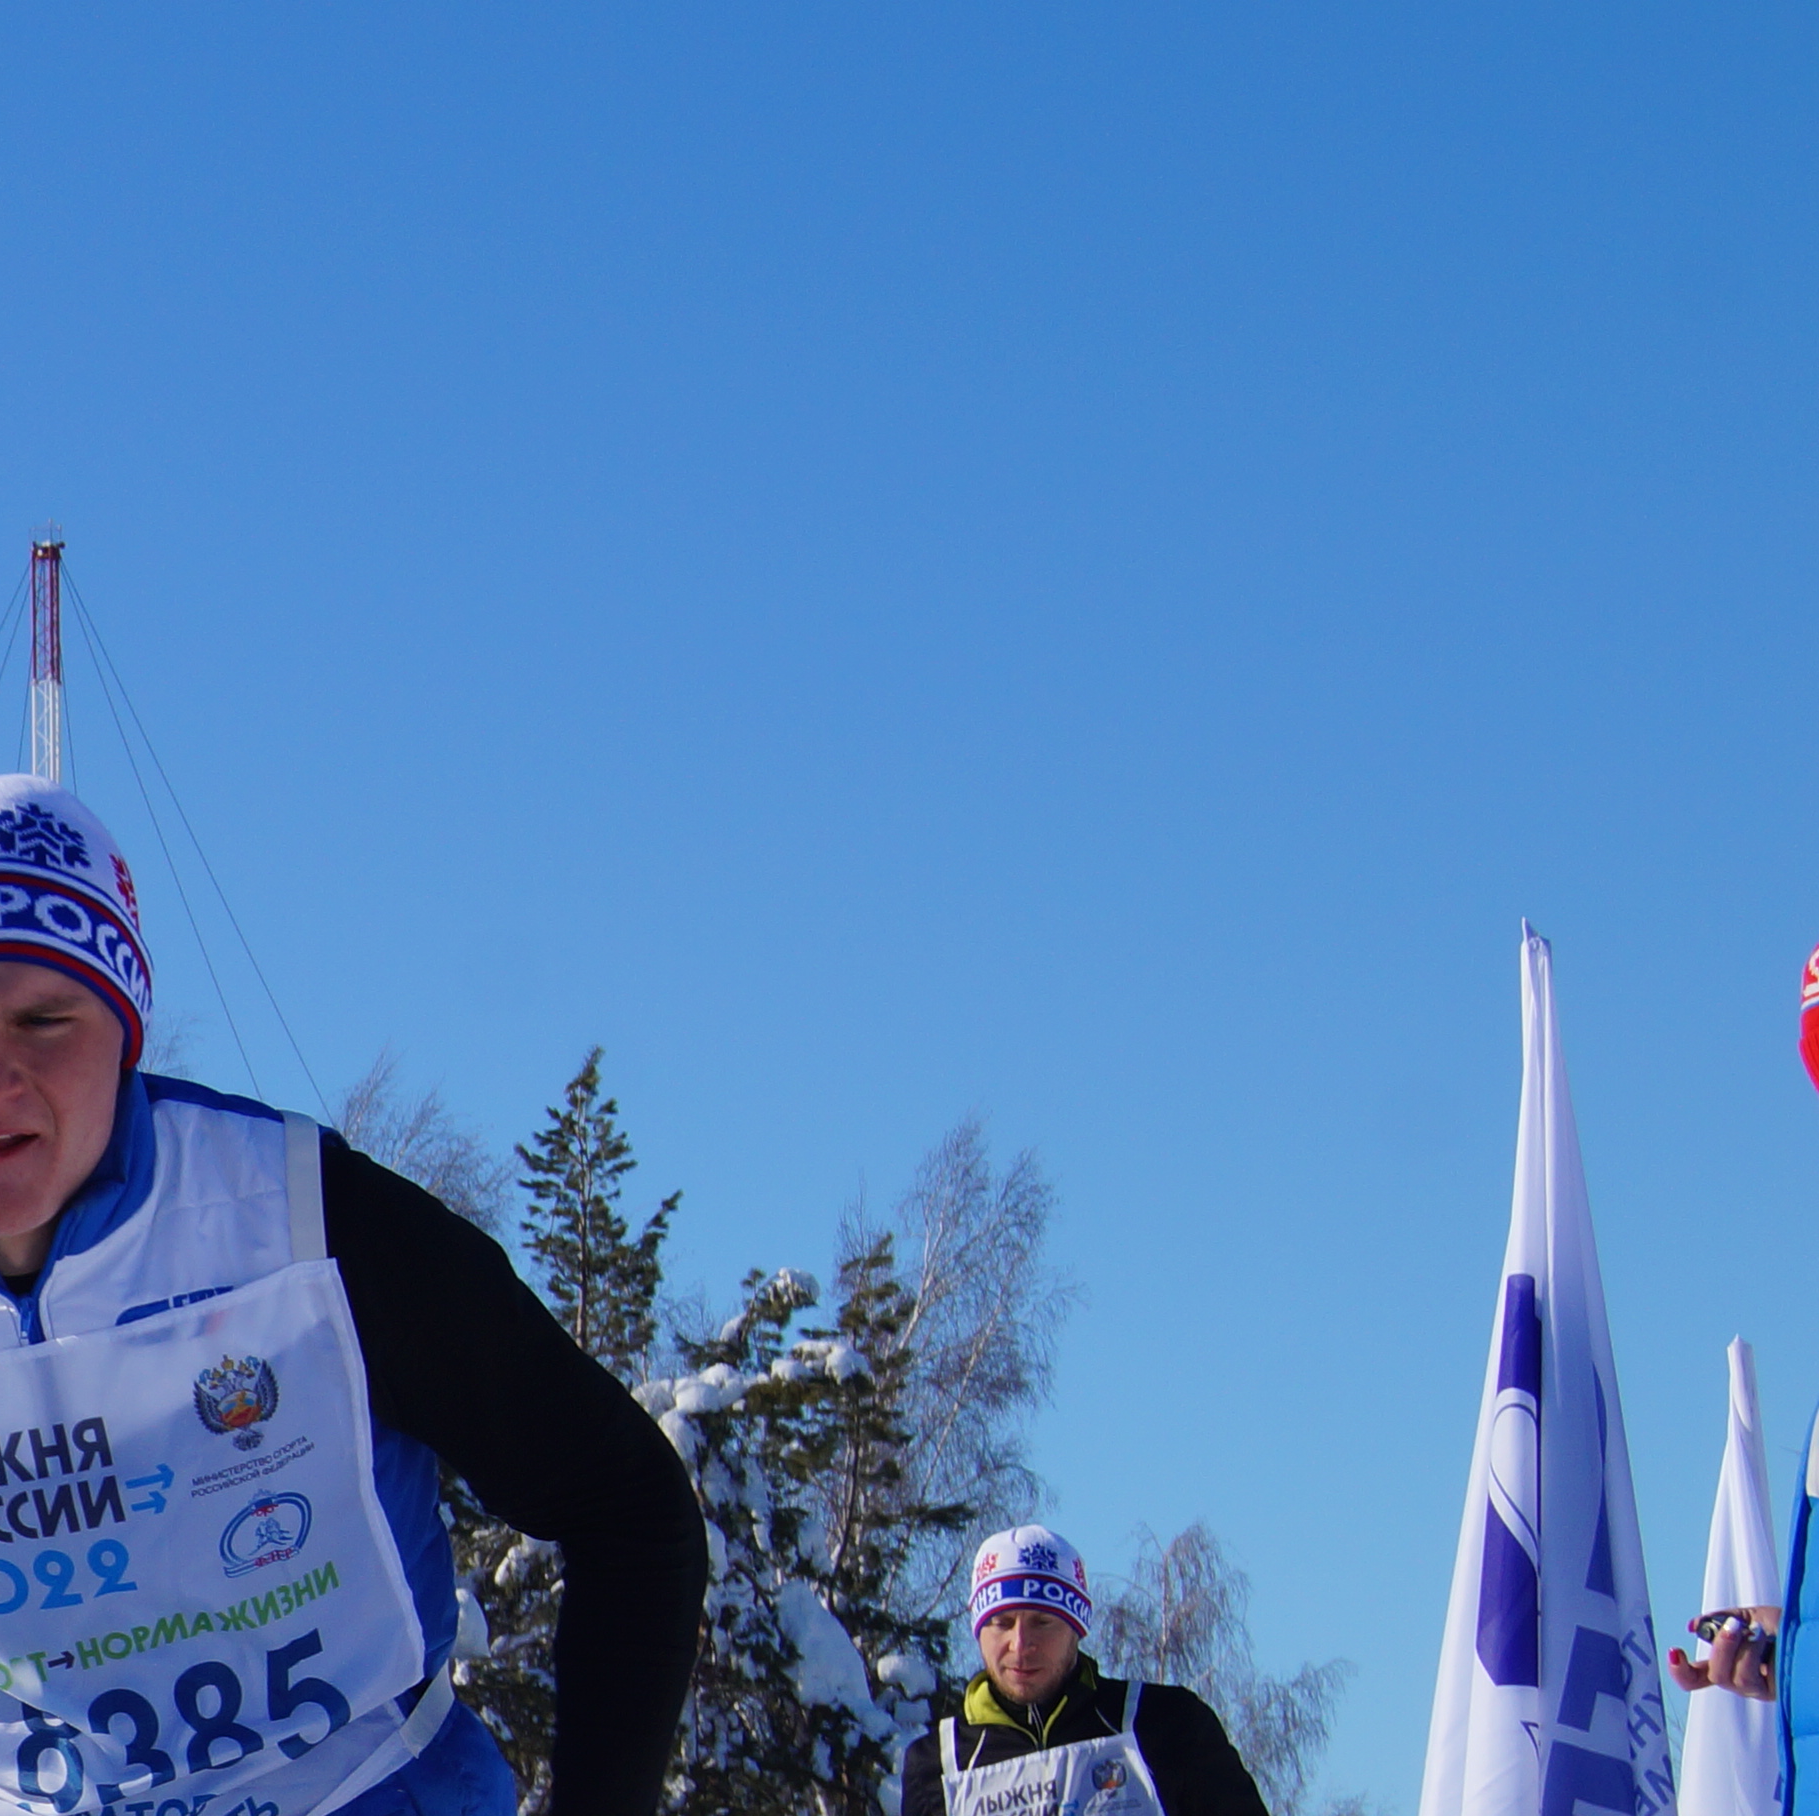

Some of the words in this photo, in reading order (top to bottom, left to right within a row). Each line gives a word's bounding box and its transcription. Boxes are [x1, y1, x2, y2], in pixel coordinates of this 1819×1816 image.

[190, 1470, 261, 1498] РОССИЙСКОЙ
[261, 1441, 315, 1476] ФЕДЕРАЦИИ
[192, 1454, 273, 1487] МИНИСТЕРСТВО
[273, 1435, 308, 1460] СПОРТА
[76, 1611, 213, 1671] НОРМА
[215, 1560, 341, 1633] ЖИЗНИ
